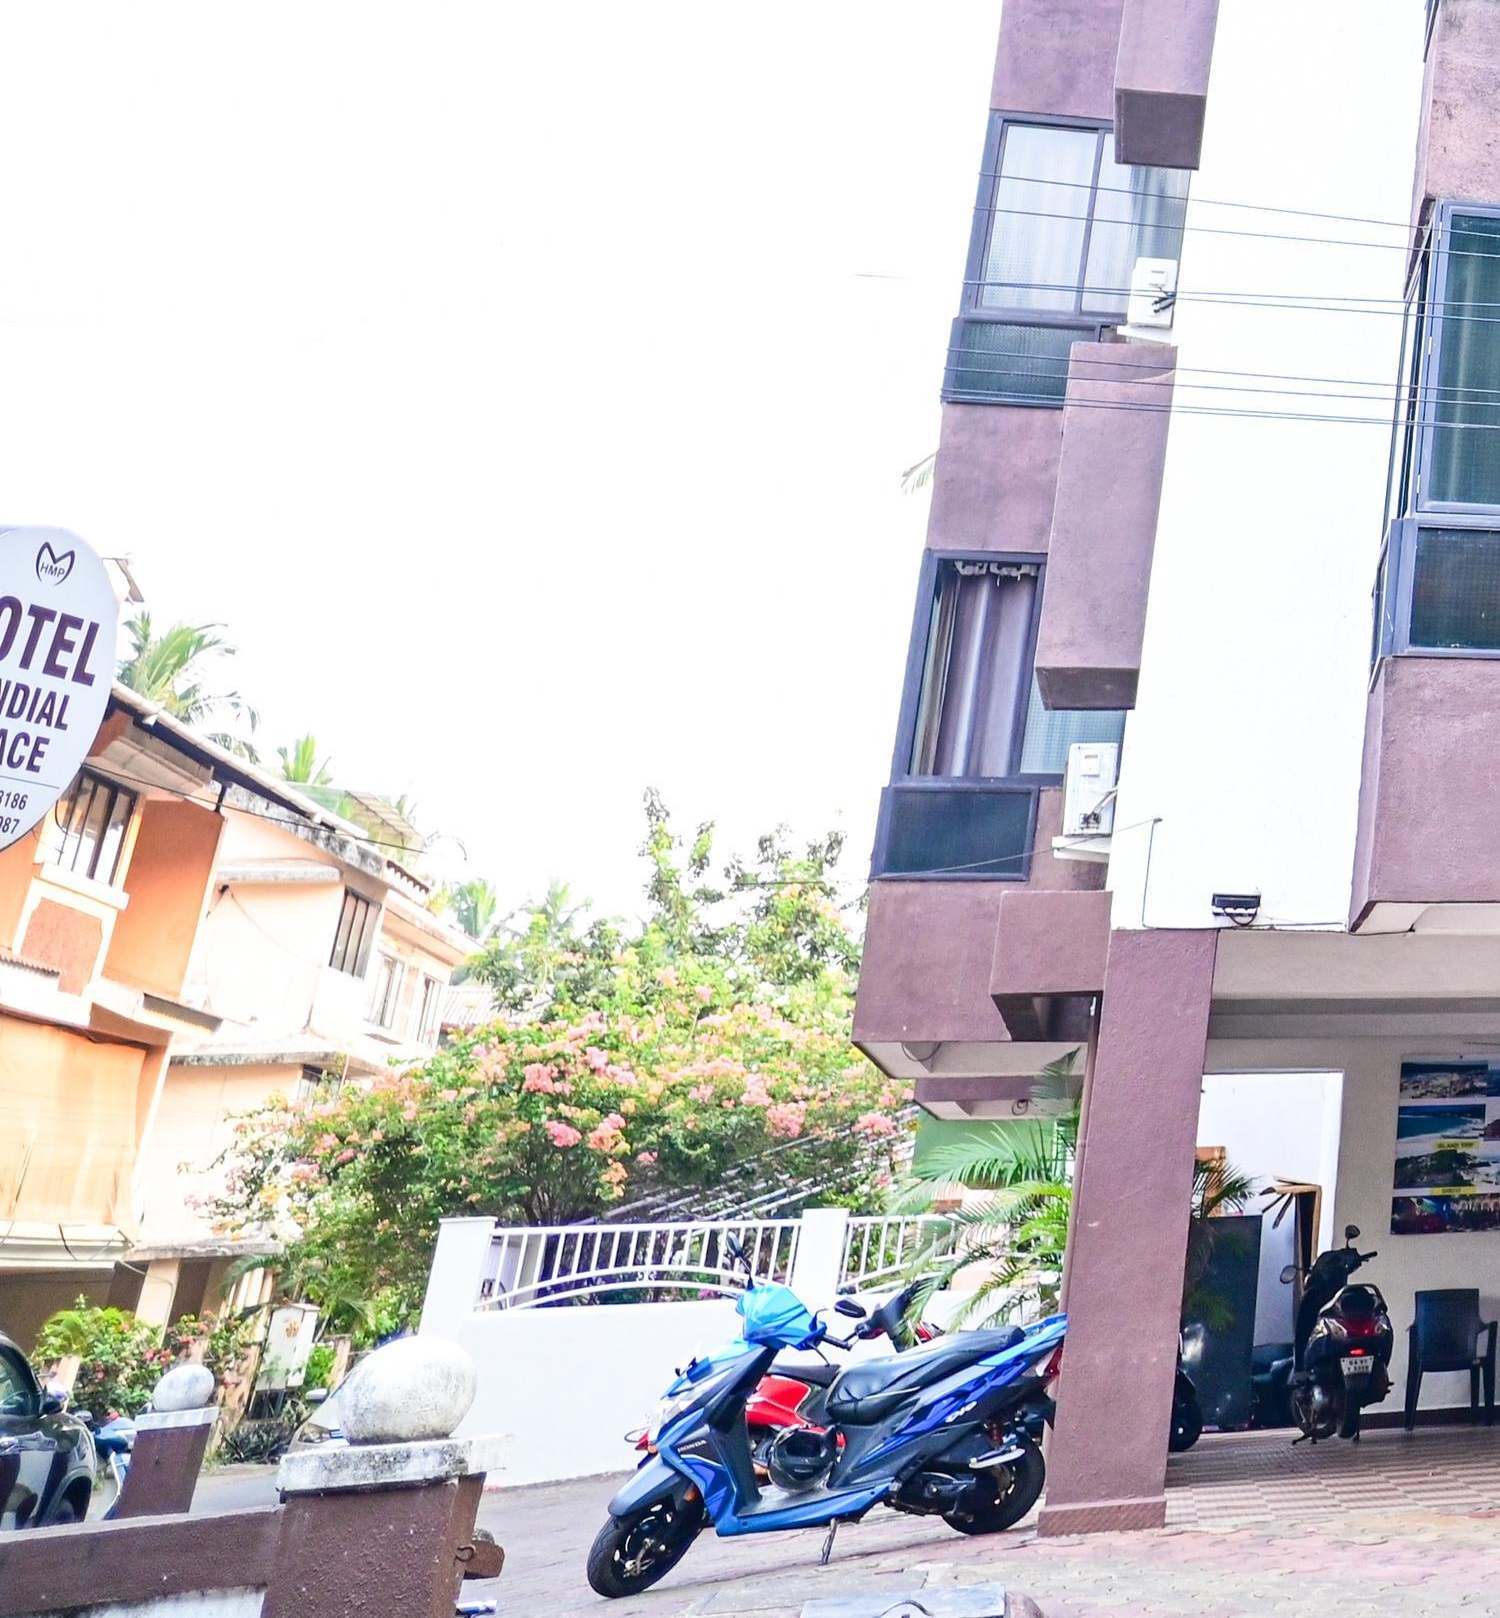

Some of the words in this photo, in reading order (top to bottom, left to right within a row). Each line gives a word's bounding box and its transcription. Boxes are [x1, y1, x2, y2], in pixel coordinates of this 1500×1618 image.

[40, 562, 65, 578] HMP
[0, 595, 100, 688] OTEL
[677, 1439, 707, 1453] HONDA
